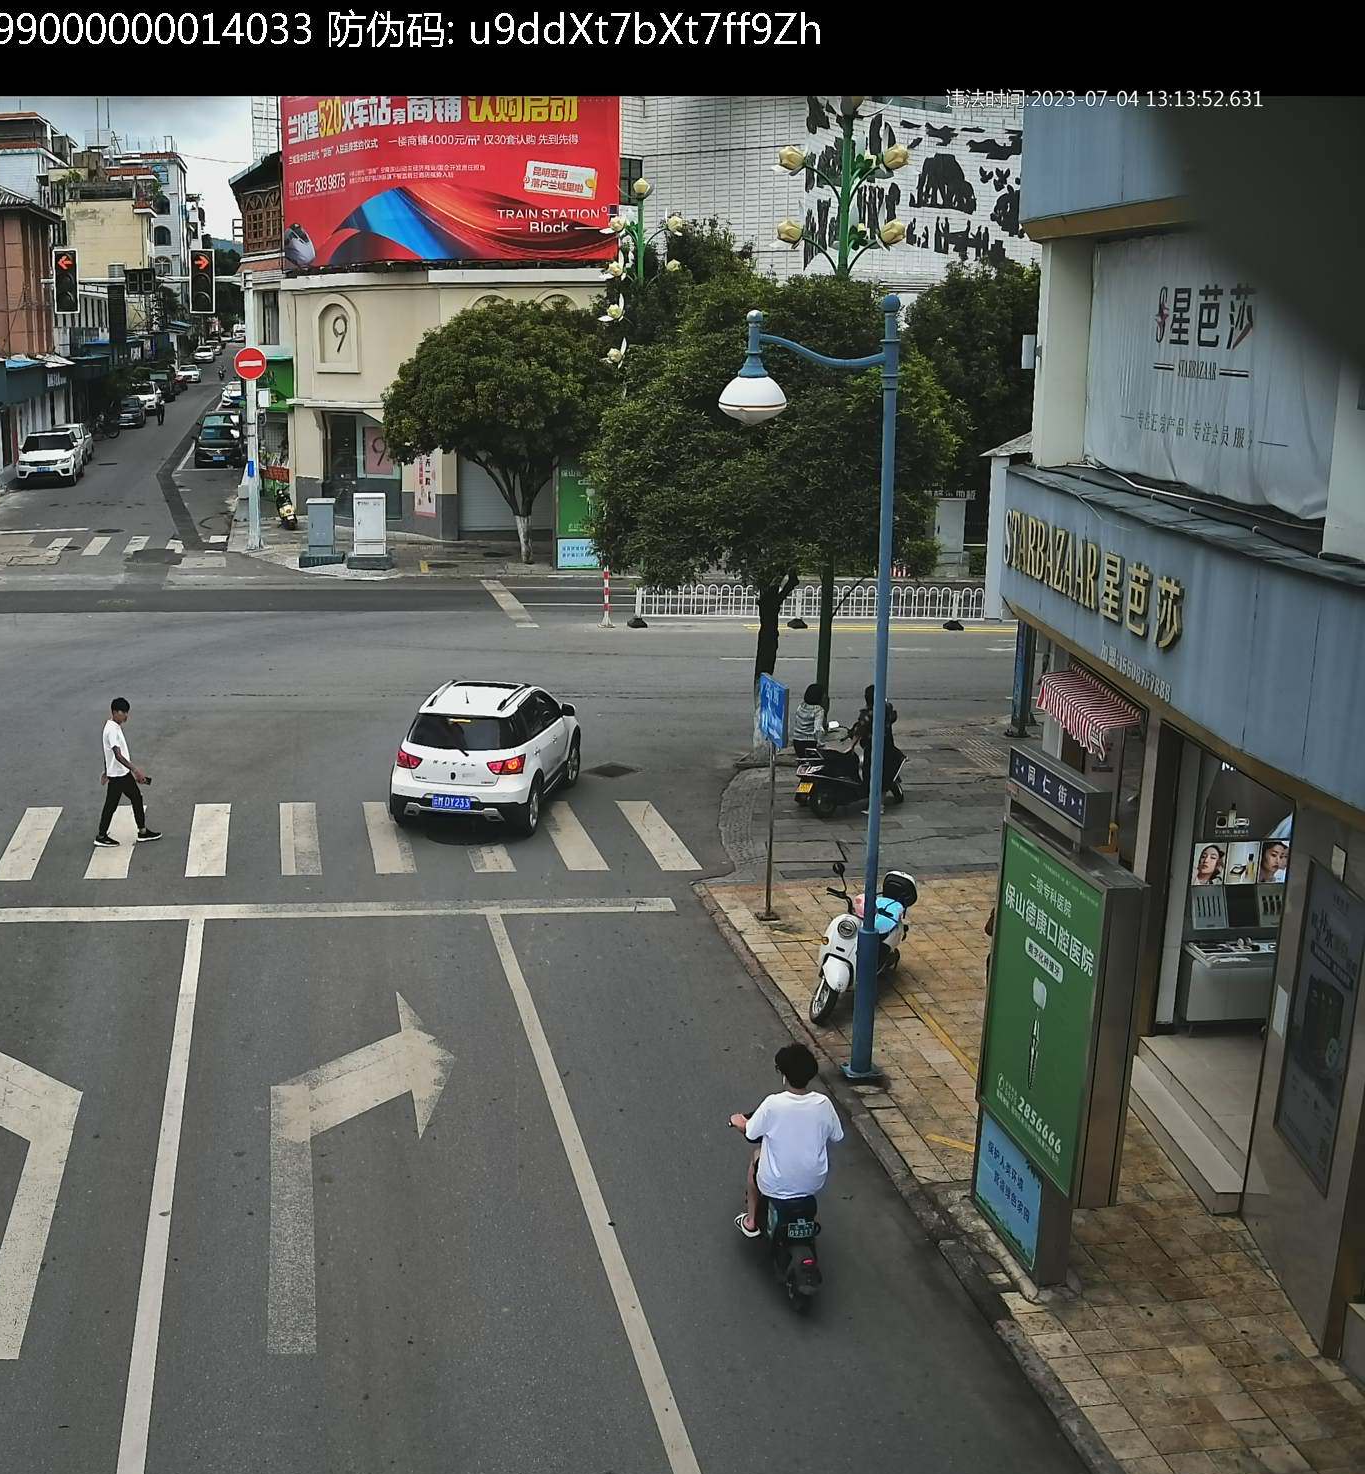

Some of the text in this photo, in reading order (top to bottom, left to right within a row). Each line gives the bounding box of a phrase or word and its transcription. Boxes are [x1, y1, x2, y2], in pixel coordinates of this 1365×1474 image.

[468, 96, 580, 123] 认购启动
[538, 134, 580, 146] 先到先得
[497, 208, 600, 220] TRAIN STATION
[529, 221, 569, 233] Block
[1169, 282, 1257, 351] 星芭莎
[1003, 508, 1184, 650] STARBAZAAR 星芭莎
[1027, 764, 1068, 807] 同仁街
[1029, 872, 1072, 919] 二级专科医院
[1005, 882, 1095, 977] 保山德康口腔医院
[1017, 1095, 1062, 1155] 2856666
